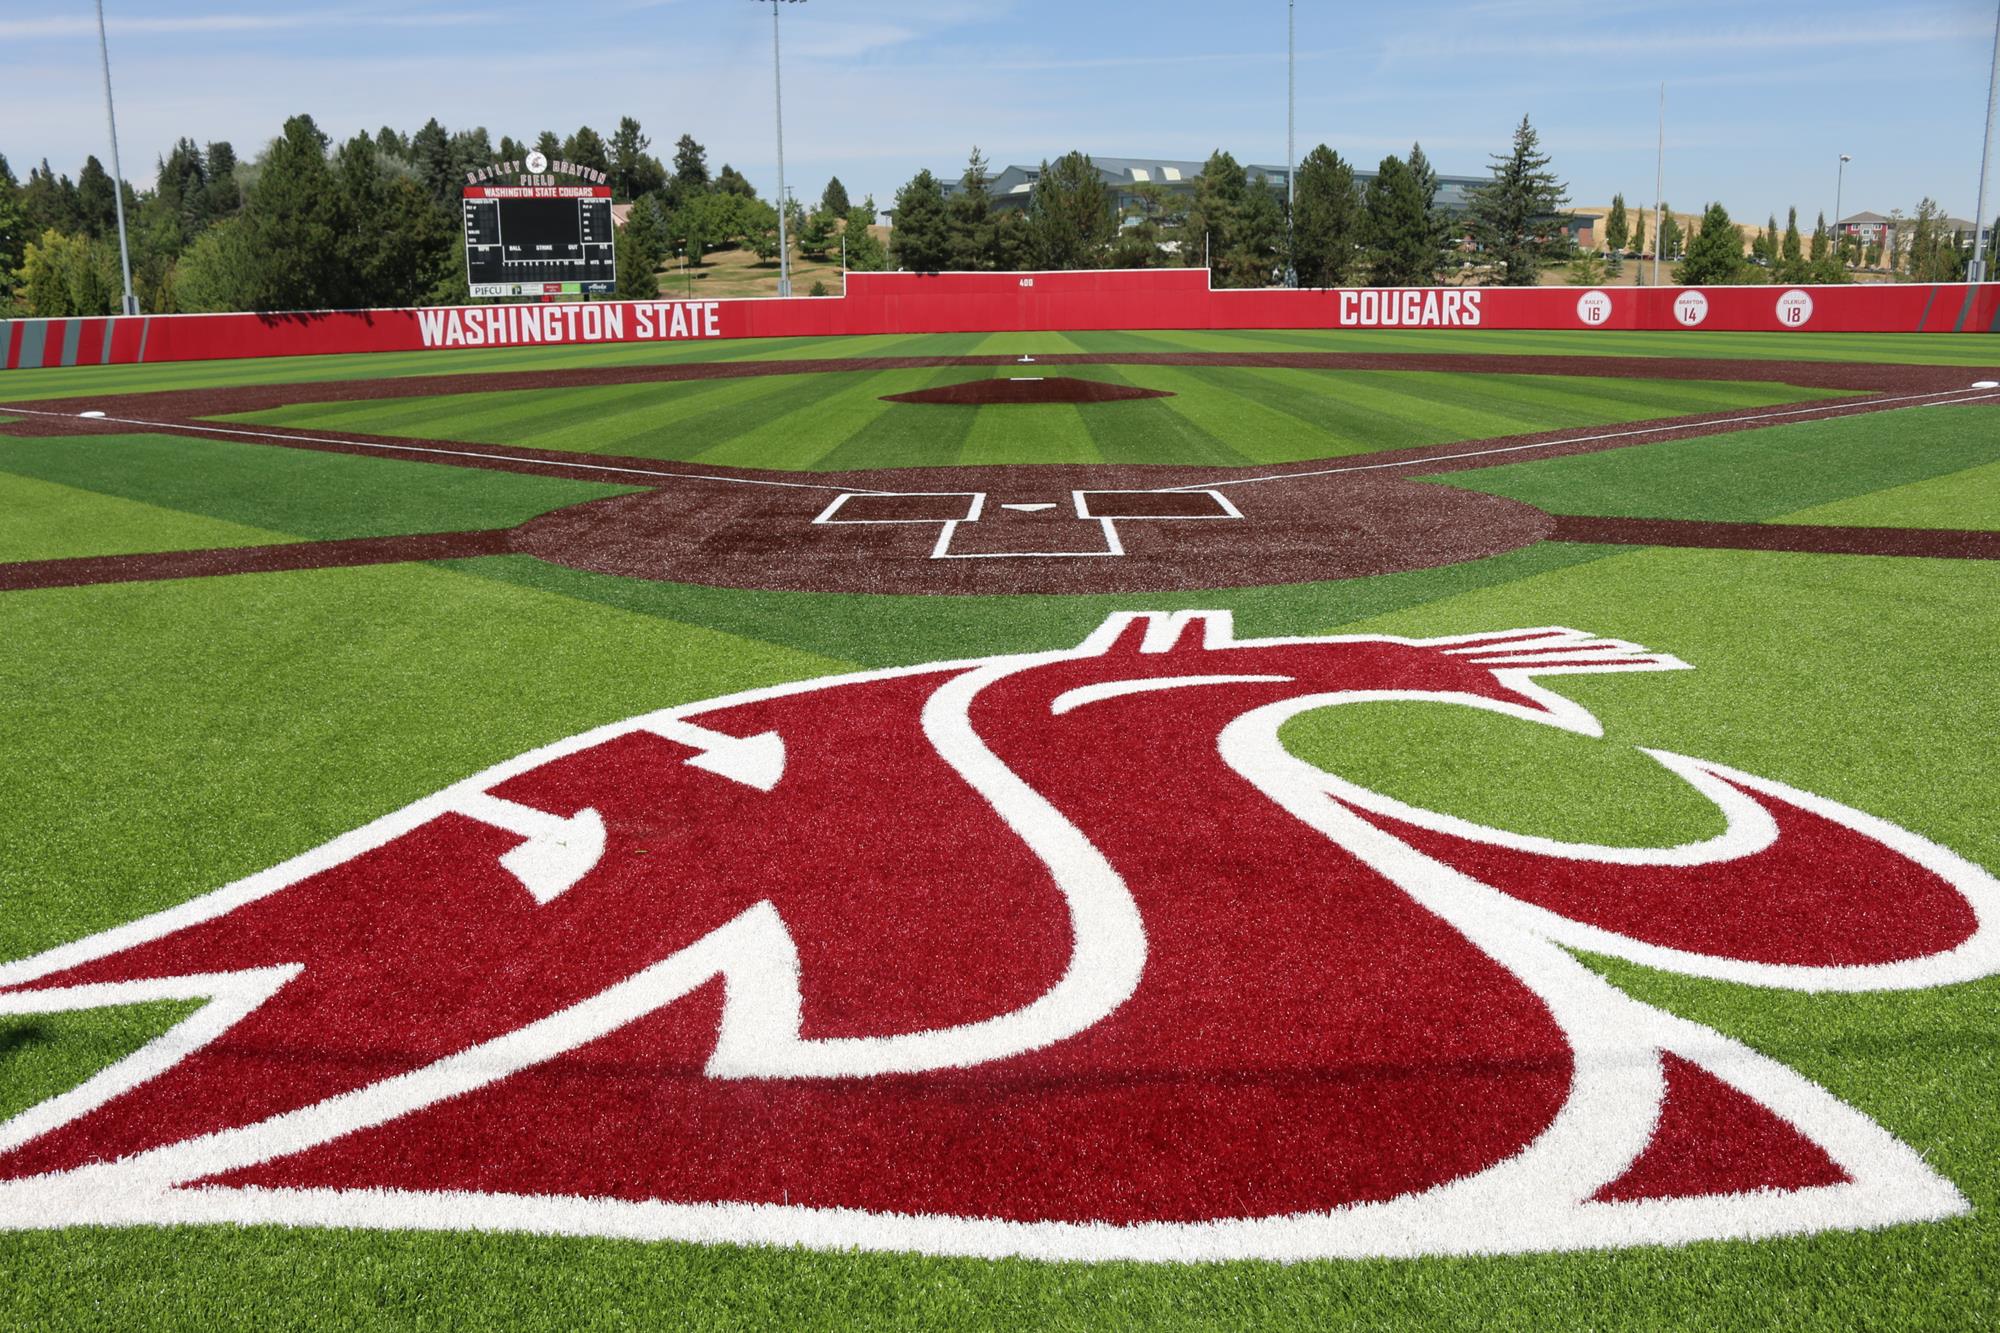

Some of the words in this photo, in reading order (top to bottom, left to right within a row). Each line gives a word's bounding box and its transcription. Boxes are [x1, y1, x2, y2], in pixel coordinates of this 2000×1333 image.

[467, 160, 519, 185] BAILEY
[552, 160, 607, 184] BRAYTON
[520, 174, 555, 186] FIELD
[484, 187, 534, 197] WASHINGTON
[535, 187, 557, 197] STATE
[558, 187, 593, 197] COUGARS
[1019, 278, 1034, 287] 400
[1338, 291, 1481, 325] COUGARS
[1587, 307, 1601, 321] 16
[1684, 307, 1697, 321] 14
[1787, 307, 1801, 322] 18
[418, 304, 624, 347] WASHINGTON
[633, 302, 721, 338] STATE
